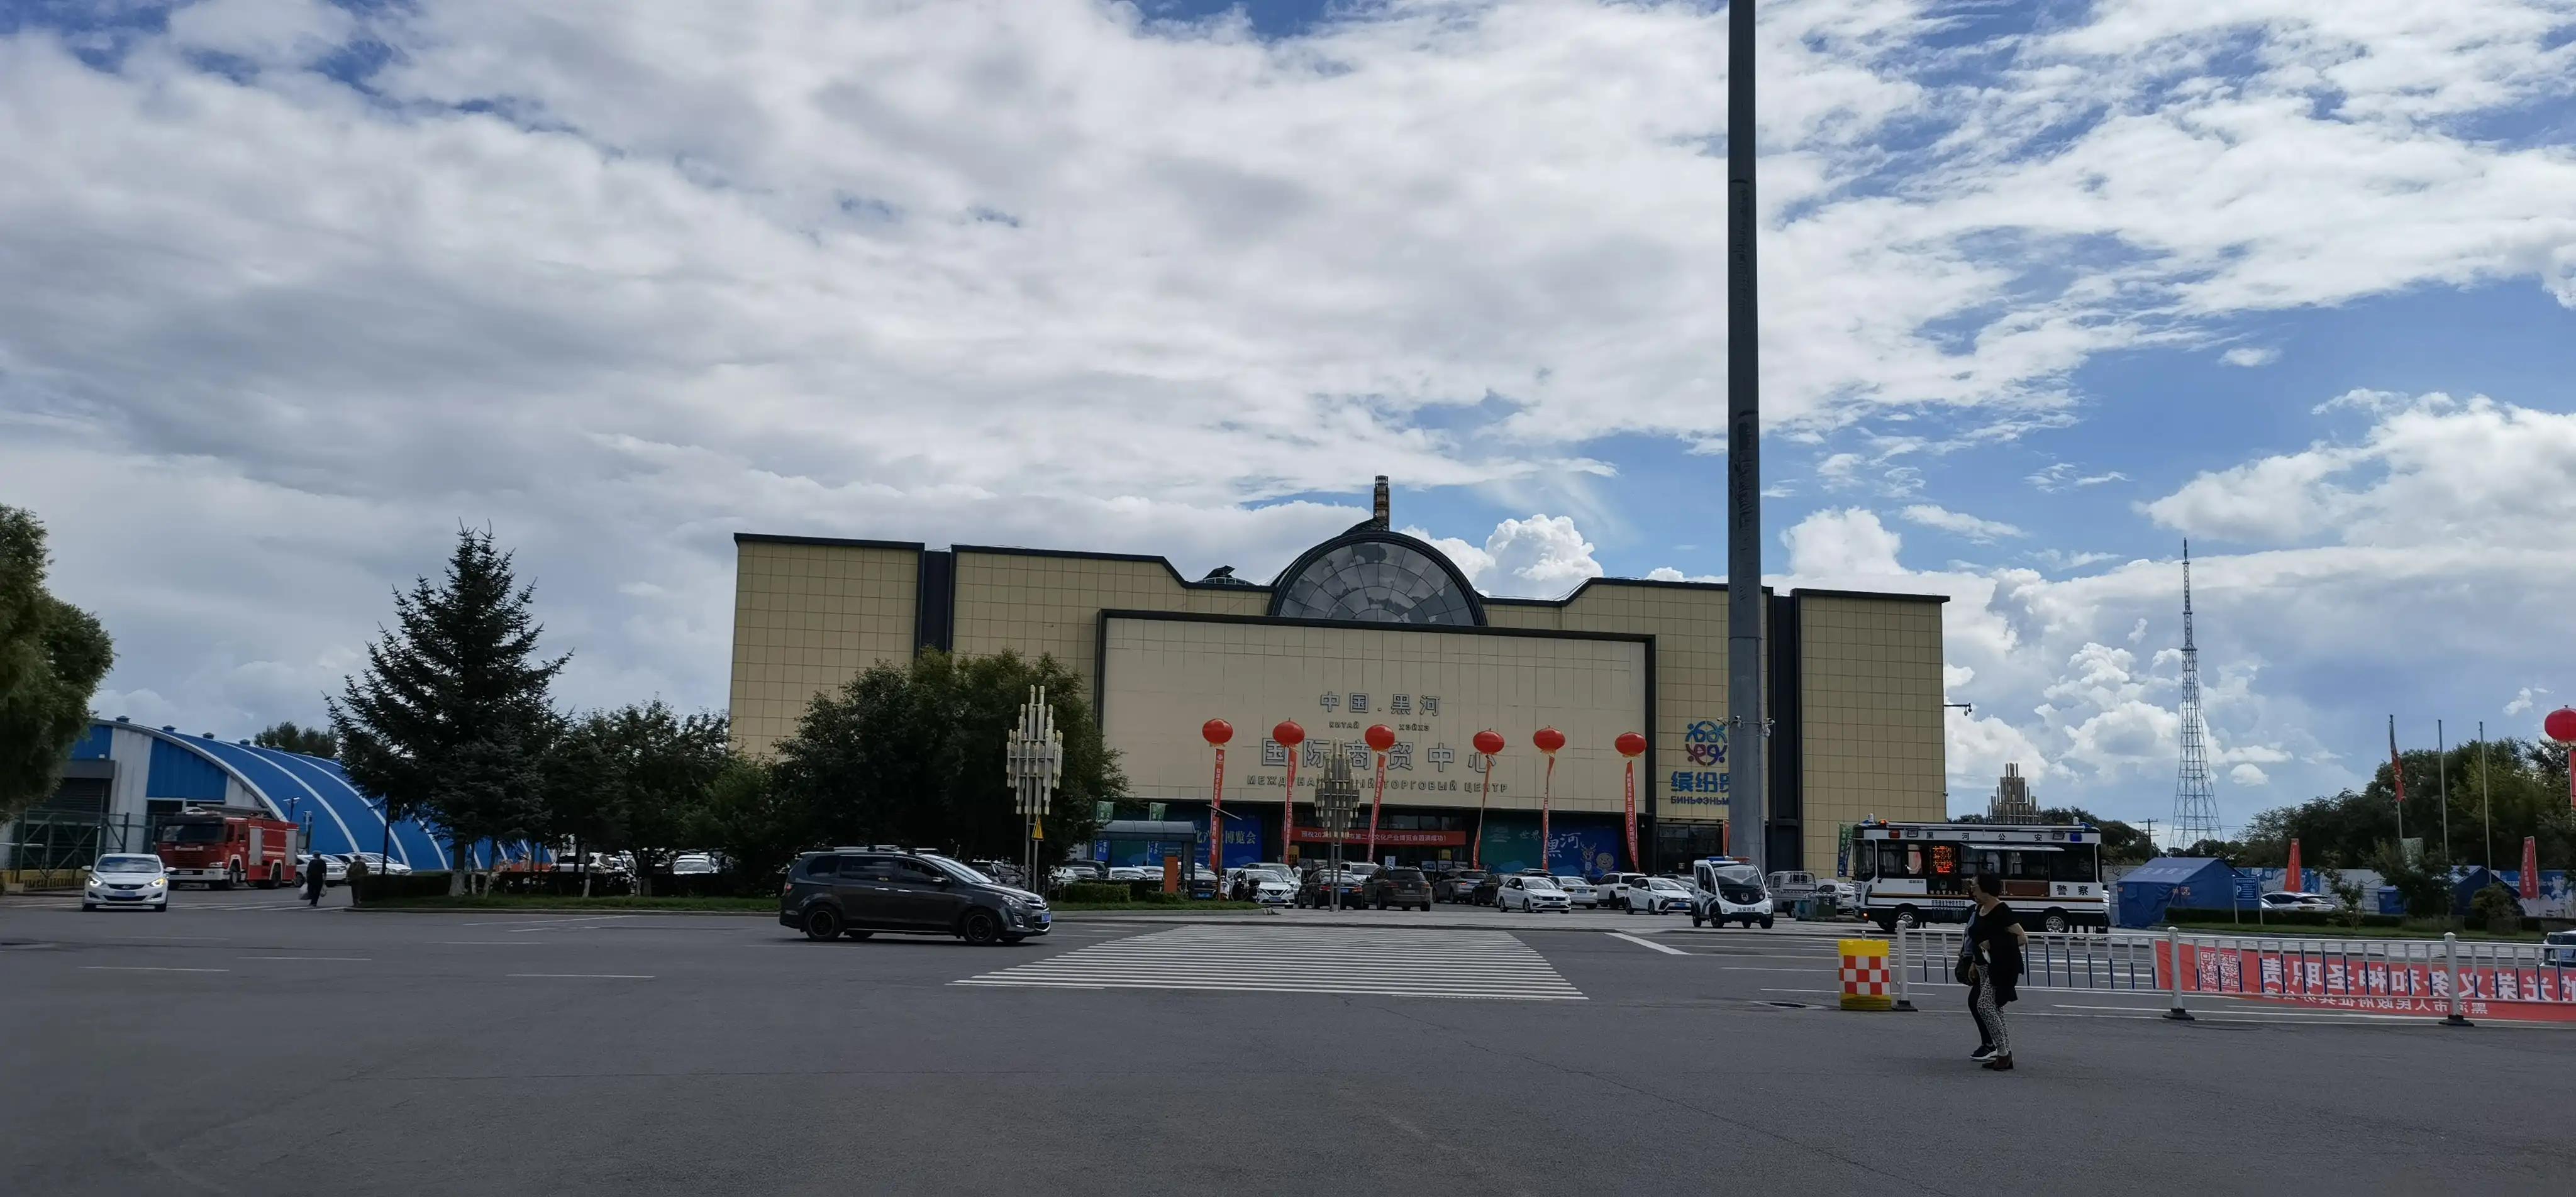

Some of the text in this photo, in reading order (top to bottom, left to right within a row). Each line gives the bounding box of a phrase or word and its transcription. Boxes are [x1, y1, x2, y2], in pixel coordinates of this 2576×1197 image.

[1329, 720, 1430, 732] КИТАЙ ХЭЙХЭ
[1262, 737, 1497, 773] 国际商贸中心
[1247, 775, 1375, 788] МЕЖДНАЫЙ
[2057, 885, 2089, 895] 警察
